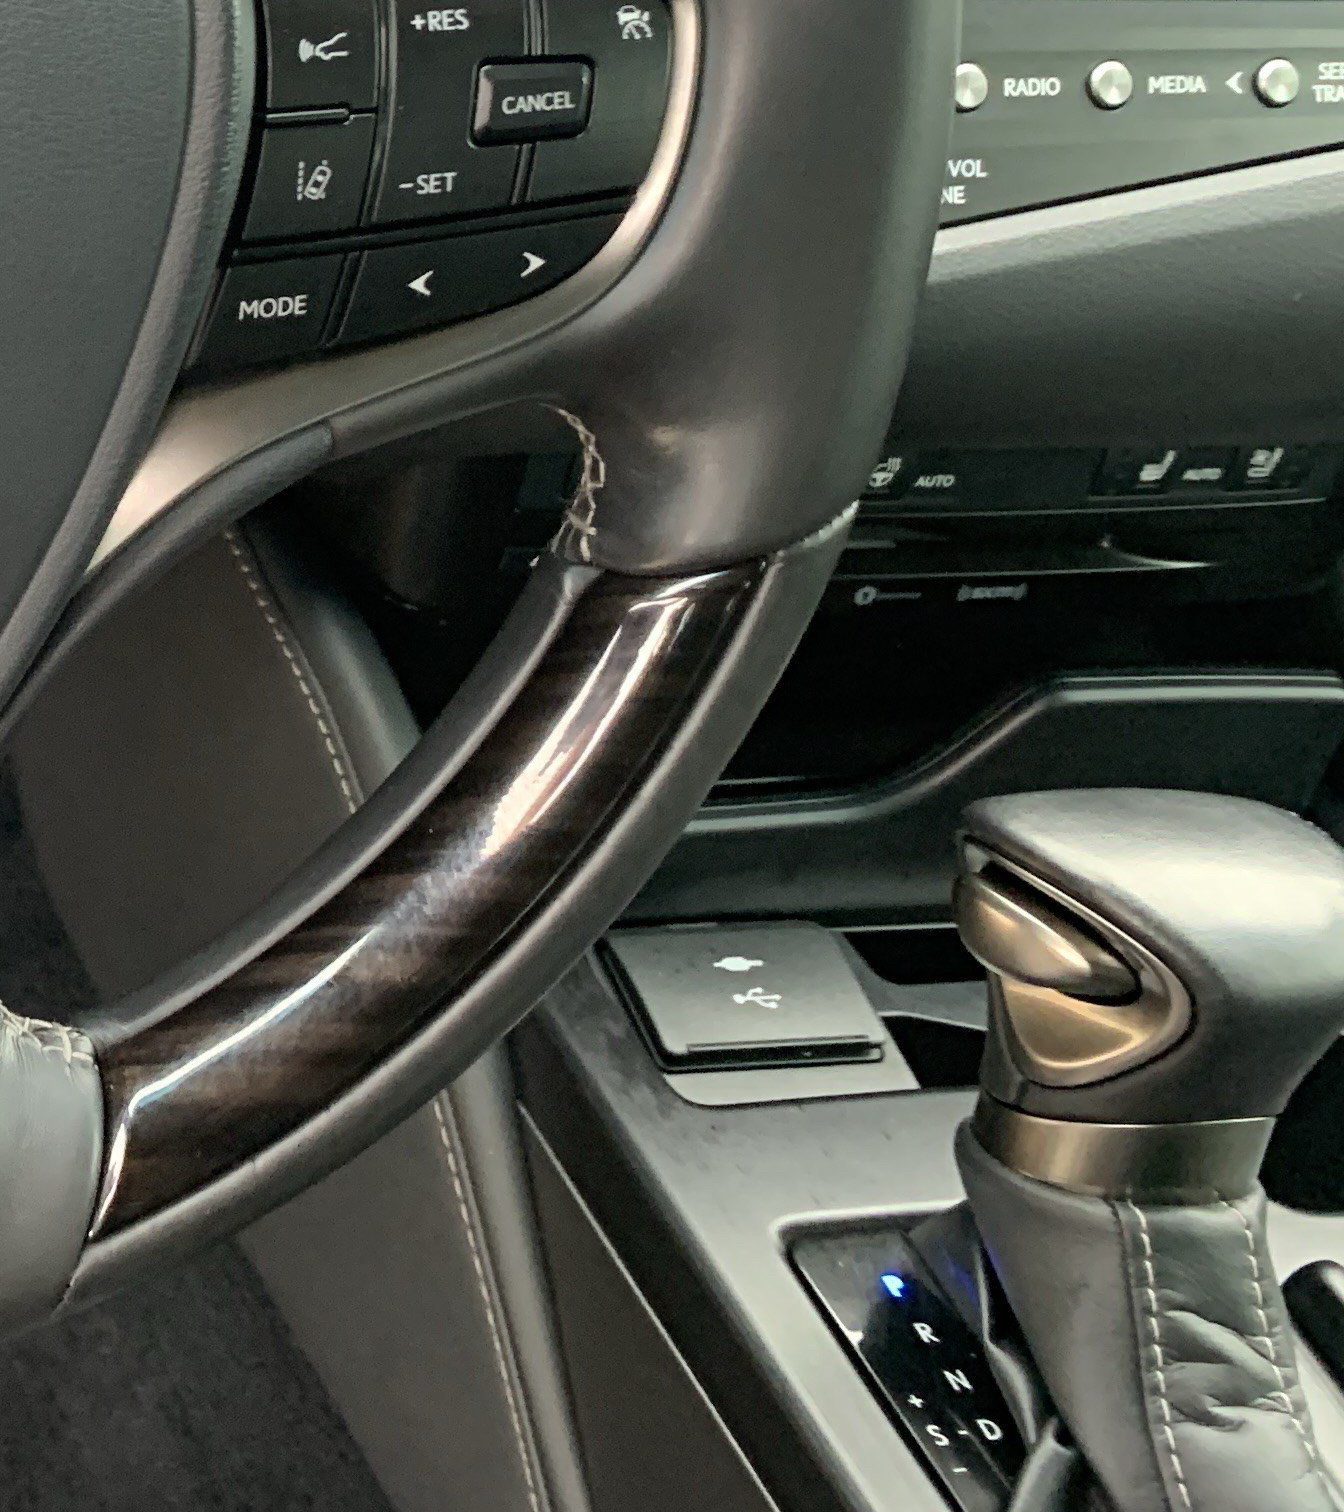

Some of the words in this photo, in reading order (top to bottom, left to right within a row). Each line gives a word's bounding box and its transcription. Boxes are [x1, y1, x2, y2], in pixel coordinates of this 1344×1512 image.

[1317, 61, 1344, 80] SE
[1003, 77, 1061, 97] RADIO
[1147, 74, 1207, 94] MEDIA
[1312, 84, 1344, 102] TRA
[501, 90, 576, 115] CANCEL
[947, 158, 988, 178] VOL
[940, 185, 967, 205] NE
[237, 294, 308, 321] MODE
[914, 474, 956, 488] AUTO
[912, 1321, 941, 1344] R
[942, 1368, 973, 1391] N
[925, 1424, 950, 1447] S
[976, 1418, 1004, 1442] D
